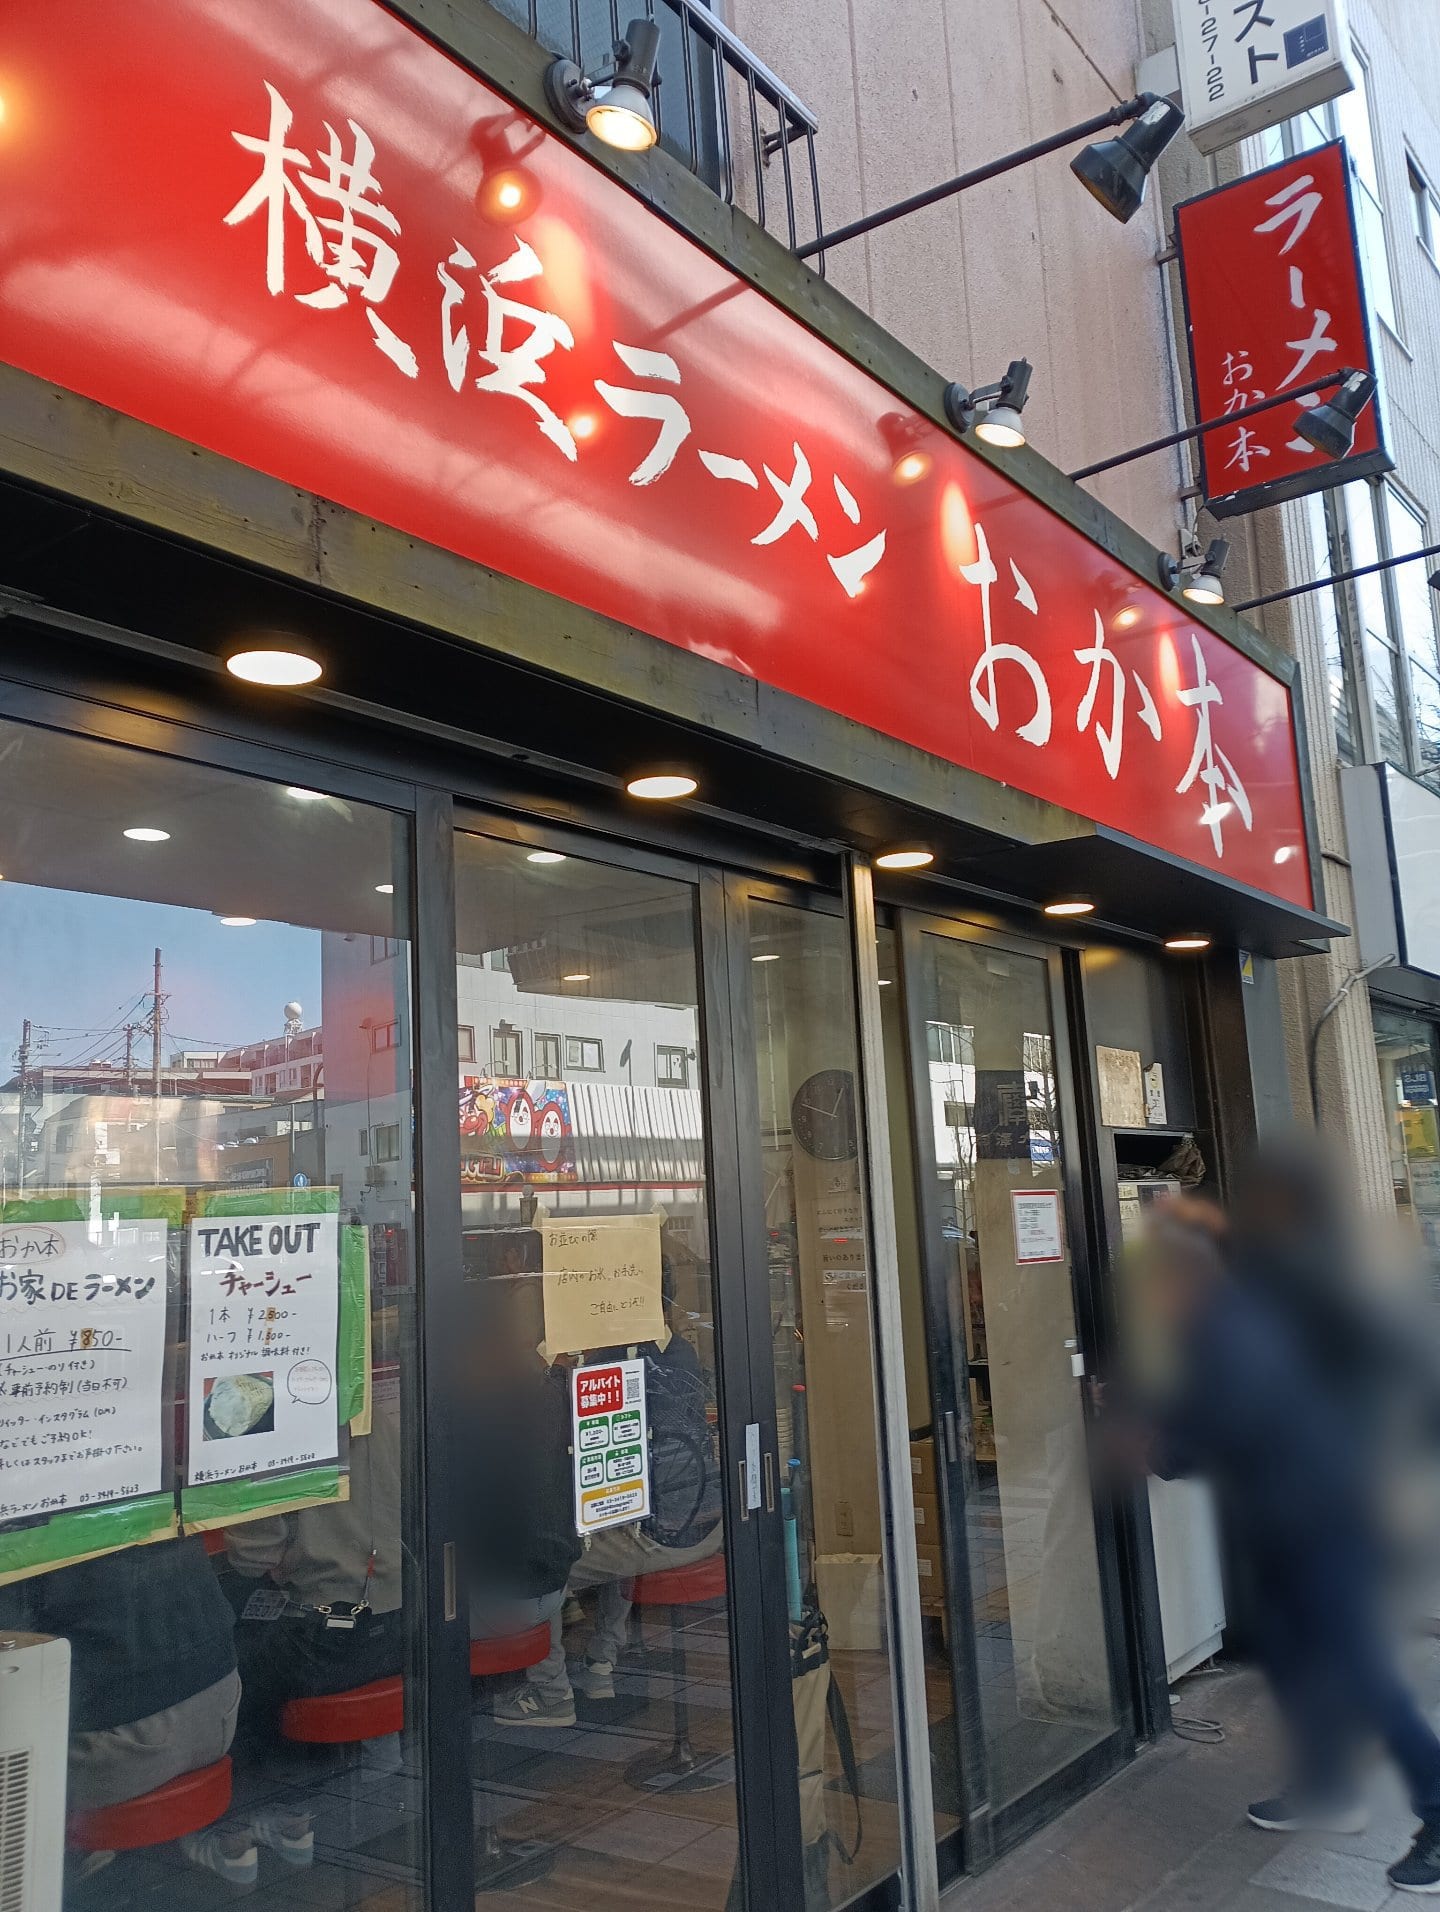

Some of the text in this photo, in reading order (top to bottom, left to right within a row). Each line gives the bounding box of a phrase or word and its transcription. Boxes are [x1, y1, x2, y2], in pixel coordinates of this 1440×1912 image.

[222, 79, 887, 598] 横浜ラーメン
[958, 522, 1253, 859] おか本
[197, 1222, 321, 1257] TAKE OUT
[219, 1263, 312, 1297] チャーシュー
[580, 1375, 621, 1393] アルバイト
